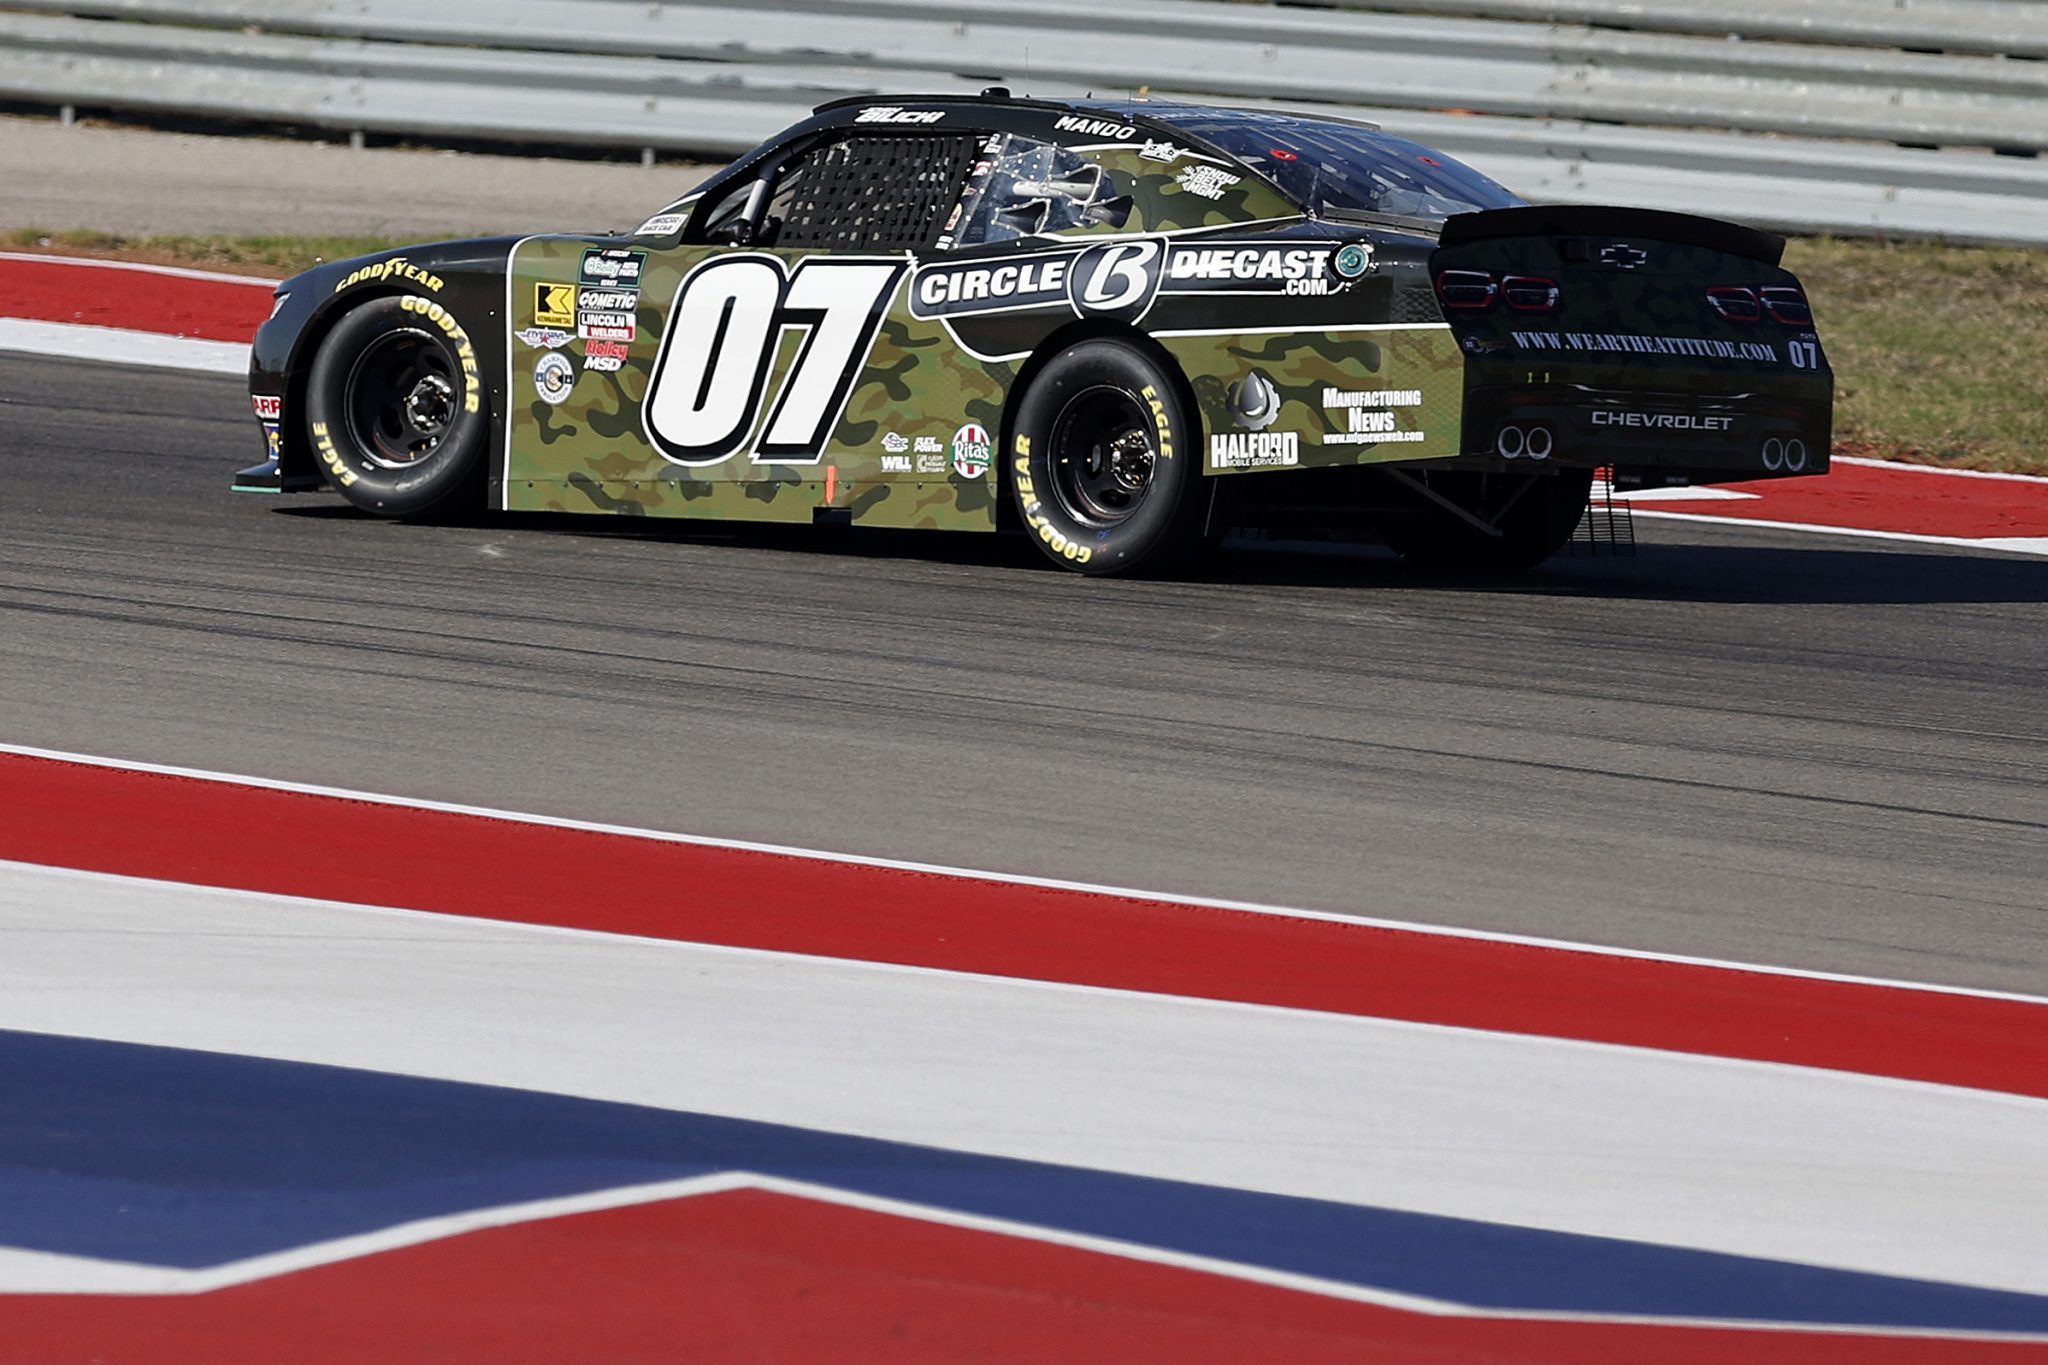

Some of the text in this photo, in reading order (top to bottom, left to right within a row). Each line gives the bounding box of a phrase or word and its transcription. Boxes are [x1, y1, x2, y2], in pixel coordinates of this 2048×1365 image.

[1054, 115, 1136, 140] MANDO
[1203, 166, 1241, 185] SNOW
[335, 257, 444, 293] GOODYEAR
[920, 241, 1330, 309] CIRCLE B DIECAST
[1281, 278, 1328, 296] .COM
[579, 292, 636, 309] COMETIC
[581, 313, 626, 327] LINCOLN
[591, 326, 629, 338] WELDERS
[400, 295, 480, 413] GOODYEAR
[586, 341, 628, 359] Holley
[642, 252, 912, 466] 07
[1511, 331, 1778, 363] WWW.WEARTHEATTITUDE.COM
[1788, 340, 1817, 370] 07
[584, 356, 622, 371] MSD
[1141, 385, 1173, 460] EAGLE
[1591, 411, 1733, 431] CHEVROLET
[312, 422, 359, 487] EAGLE
[954, 440, 989, 461] Rita's
[1211, 431, 1298, 468] HALFORD
[881, 456, 912, 469] WILL
[1014, 433, 1092, 564] GOODYEAR
